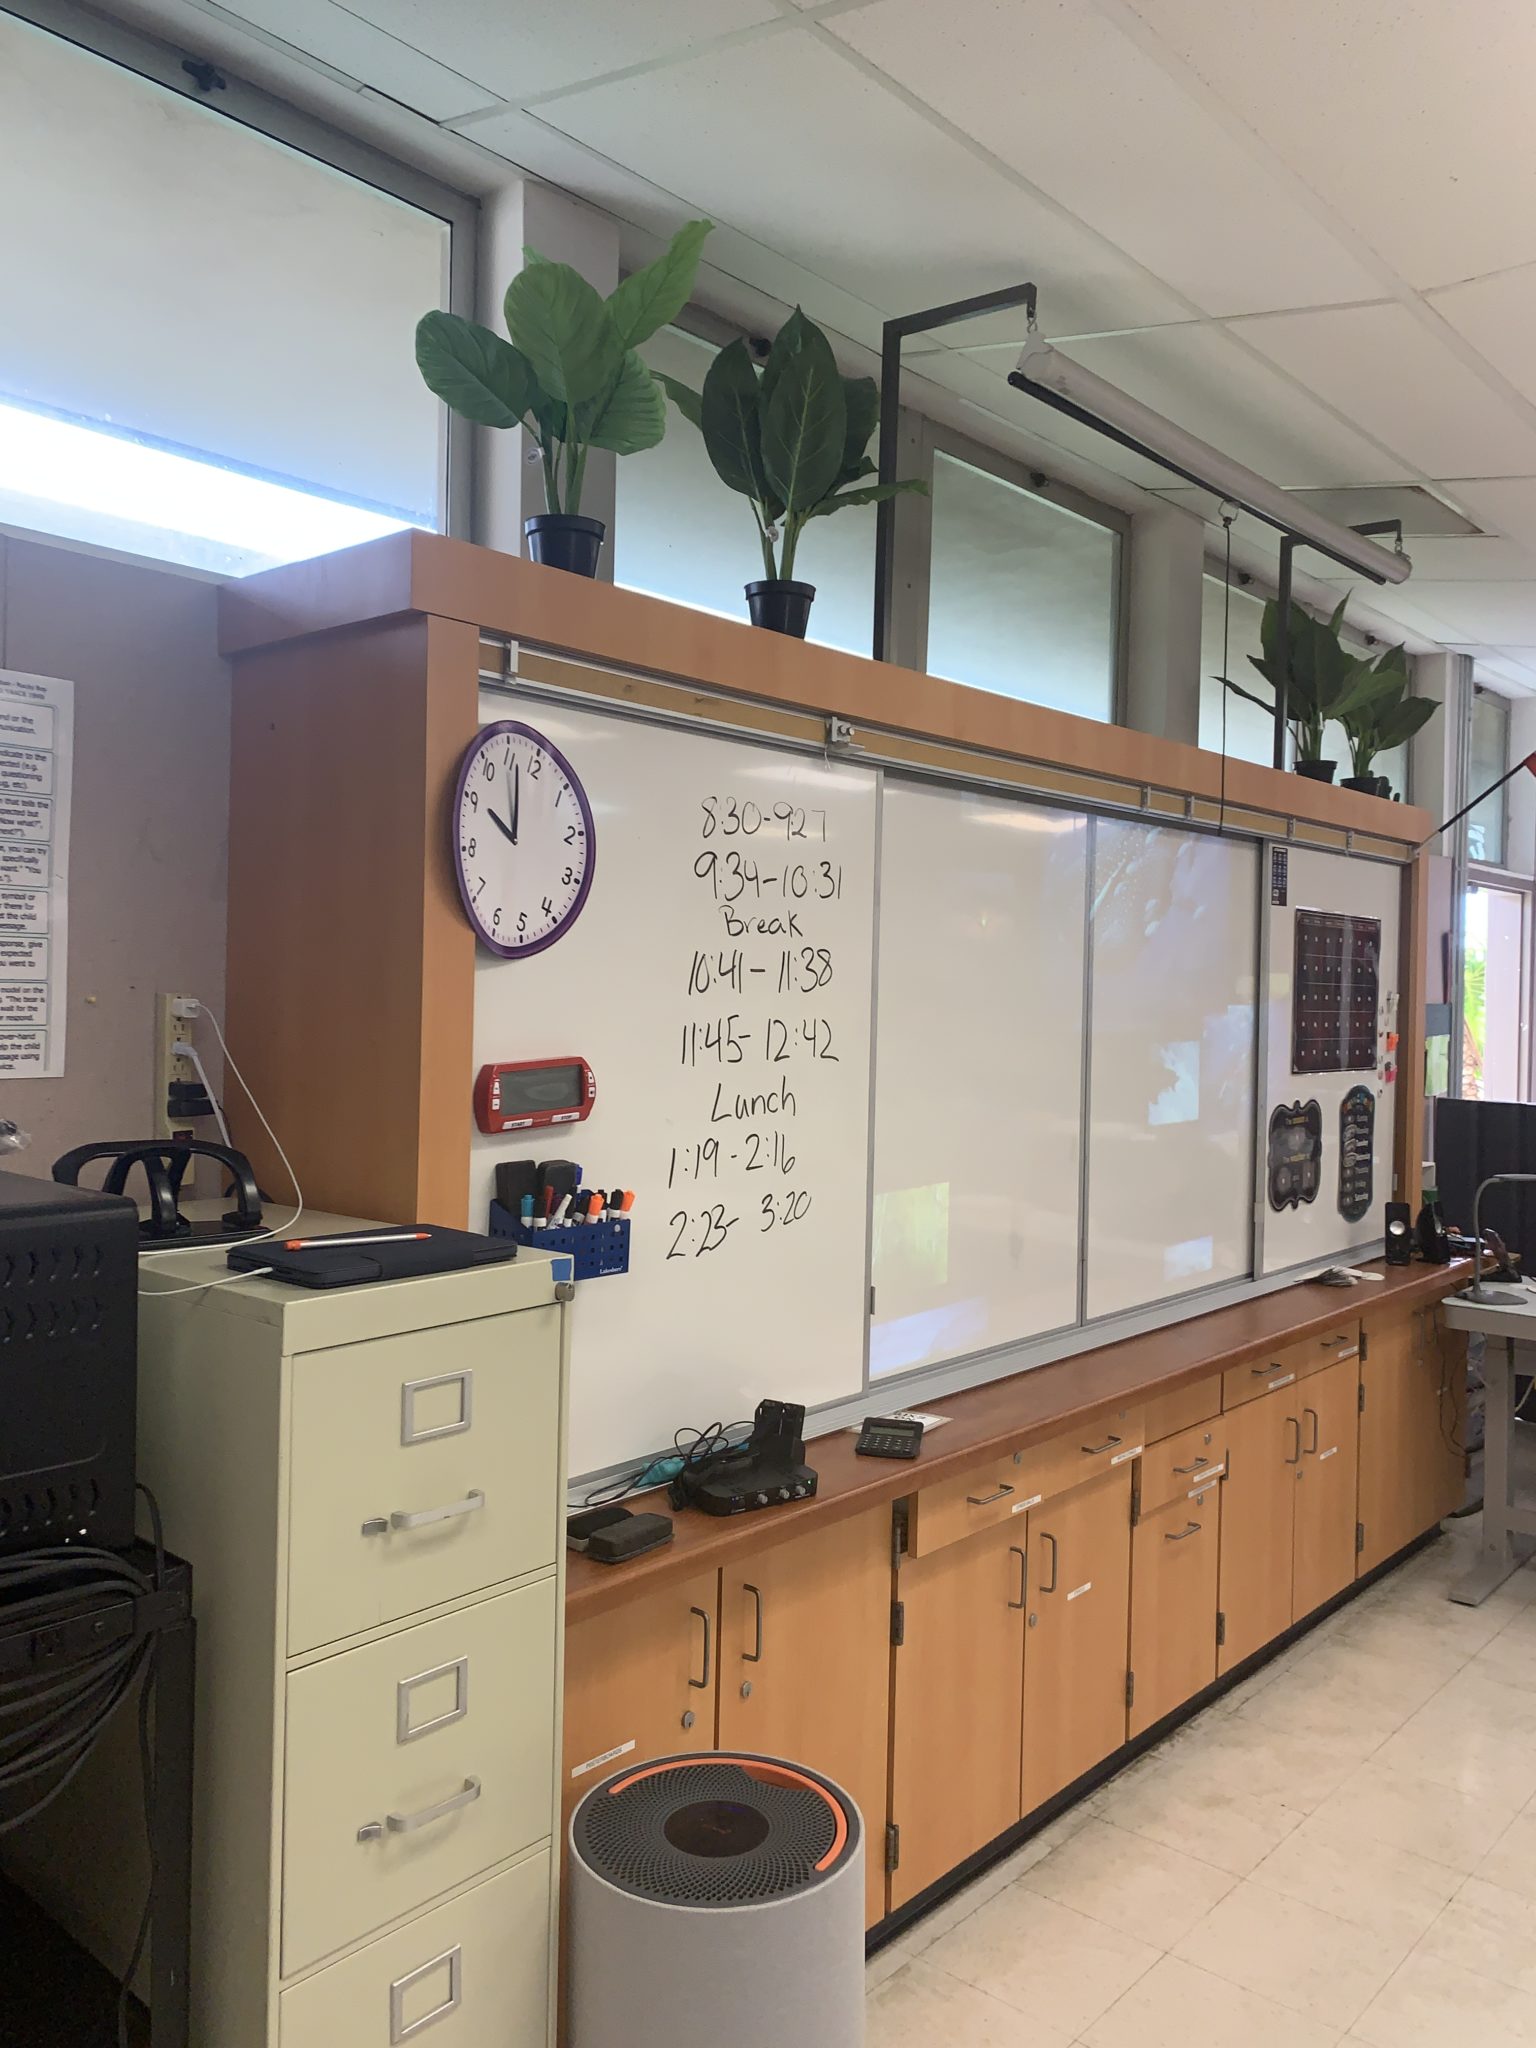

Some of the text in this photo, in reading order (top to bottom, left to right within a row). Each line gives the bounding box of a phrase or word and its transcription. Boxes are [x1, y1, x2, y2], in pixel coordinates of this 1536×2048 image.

[482, 757, 496, 782] 10
[504, 747, 516, 771] 11
[527, 755, 542, 780] 12
[469, 791, 479, 814] 9
[555, 790, 563, 808] 1
[563, 825, 576, 846] 2
[467, 838, 477, 858] 8
[476, 876, 487, 896] 7
[561, 867, 573, 886] 3
[492, 908, 502, 926] 6
[541, 896, 553, 918] 4
[516, 912, 528, 932] 5
[718, 904, 803, 938] Break
[711, 1075, 796, 1122] Lunch
